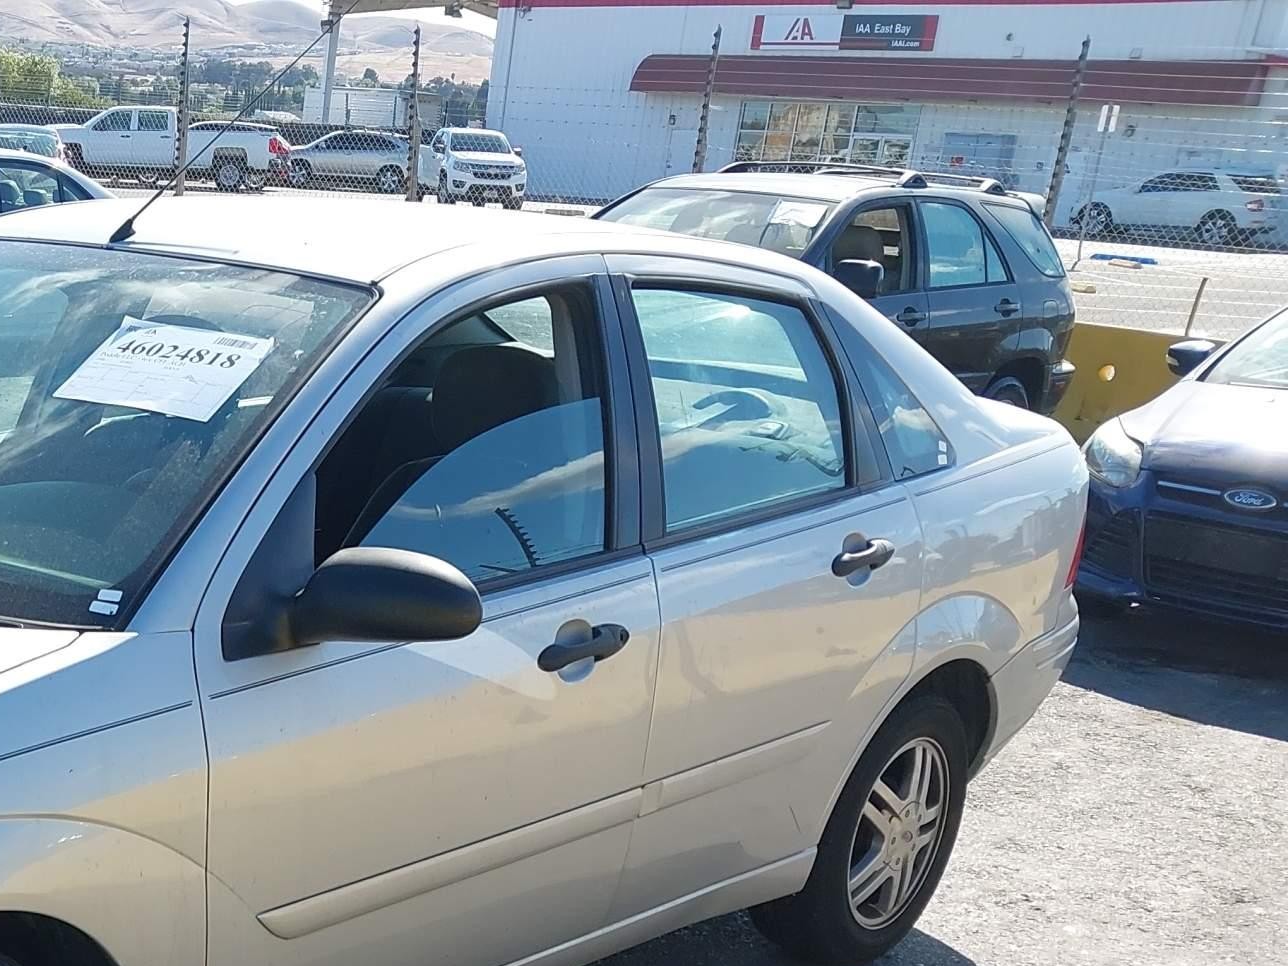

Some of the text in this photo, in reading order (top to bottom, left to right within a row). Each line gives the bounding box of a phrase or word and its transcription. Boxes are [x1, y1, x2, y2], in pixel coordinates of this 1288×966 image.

[855, 23, 912, 37] IAA East Bay
[116, 339, 241, 369] 46024818
[1234, 491, 1265, 506] Ford
